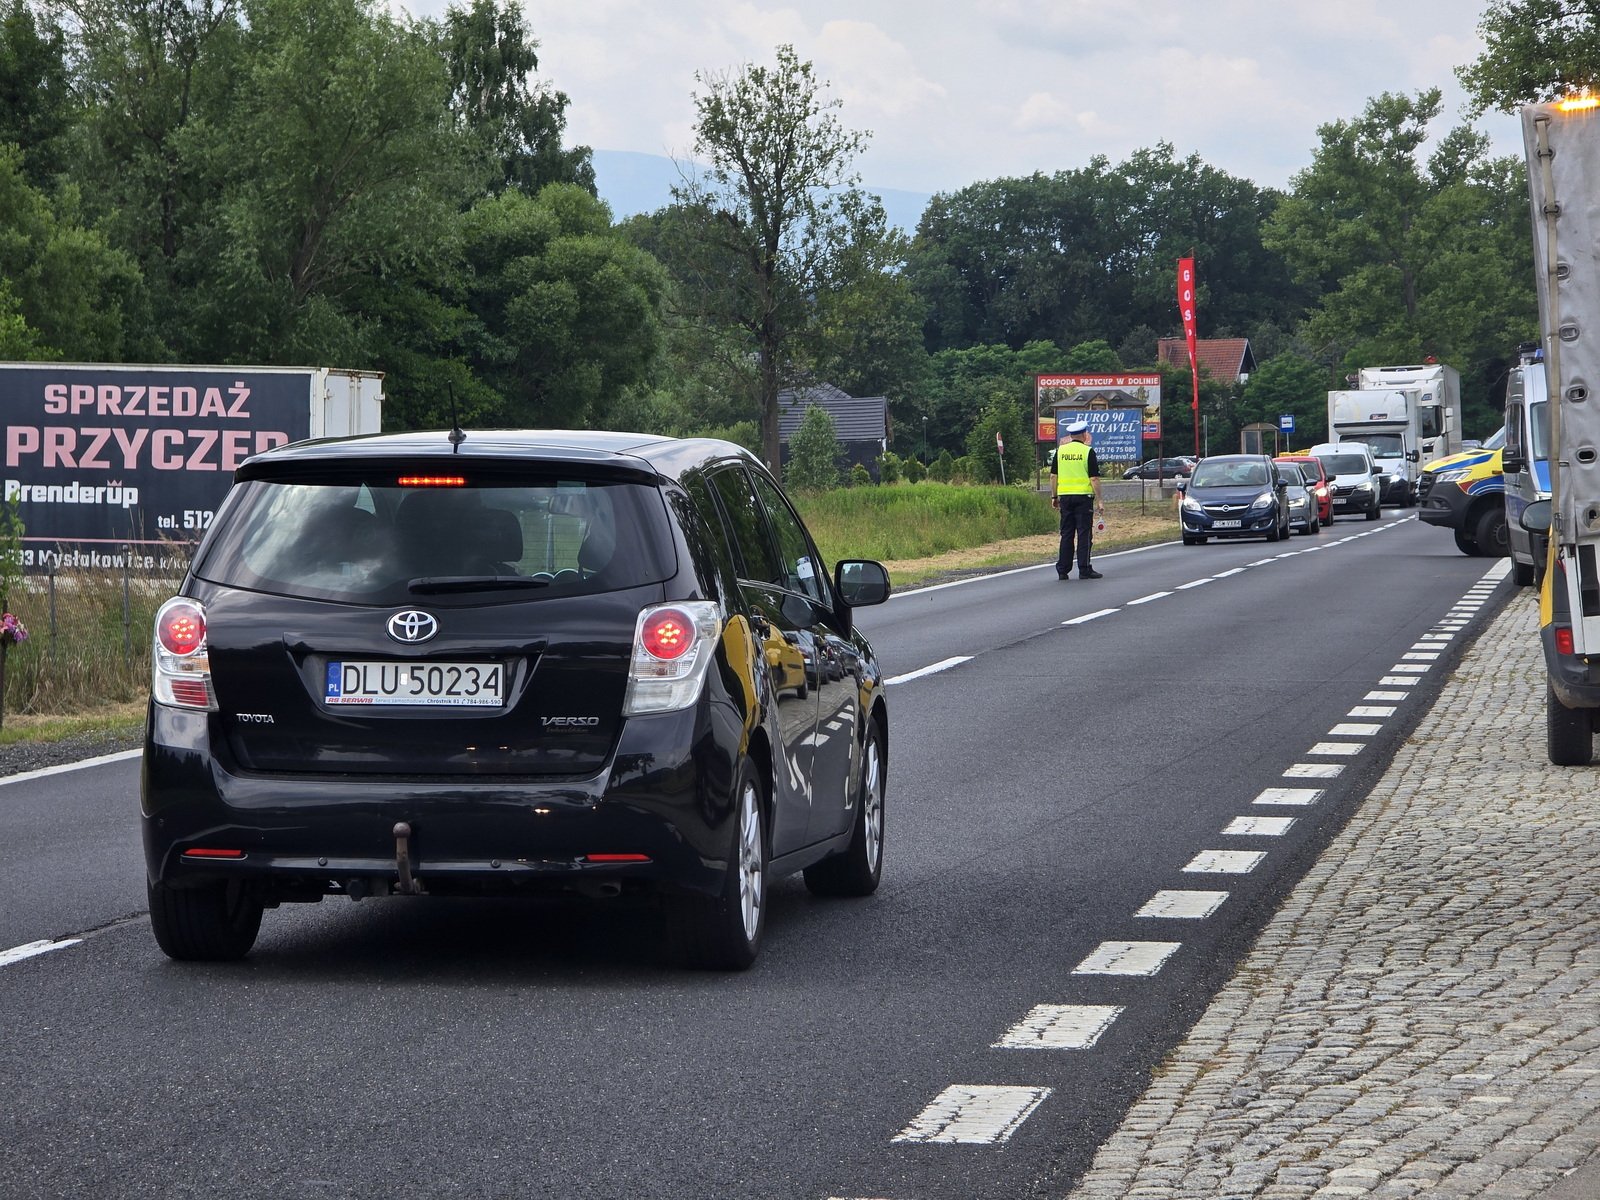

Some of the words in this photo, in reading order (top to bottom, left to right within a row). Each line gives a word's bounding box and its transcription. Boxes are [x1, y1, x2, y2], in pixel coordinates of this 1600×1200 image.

[1040, 378, 1077, 386] GOSPODA
[1080, 378, 1114, 386] PRZYCUP
[1116, 377, 1125, 385] W
[1128, 377, 1159, 385] DOLINIE
[44, 381, 251, 418] SPRZEDAŻ
[1075, 412, 1110, 423] EURO
[1112, 412, 1125, 422] 90
[1090, 422, 1137, 433] TRAVEL
[1061, 453, 1083, 461] POLICJA
[1096, 453, 1137, 461] o90-travel.pl
[157, 515, 179, 529] tel.
[38, 549, 154, 570] Mysłakowice
[342, 665, 399, 695] DLU
[409, 665, 499, 697] 50234
[328, 683, 339, 692] PL
[236, 713, 275, 723] TOYOTA
[540, 716, 600, 726] VERSO
